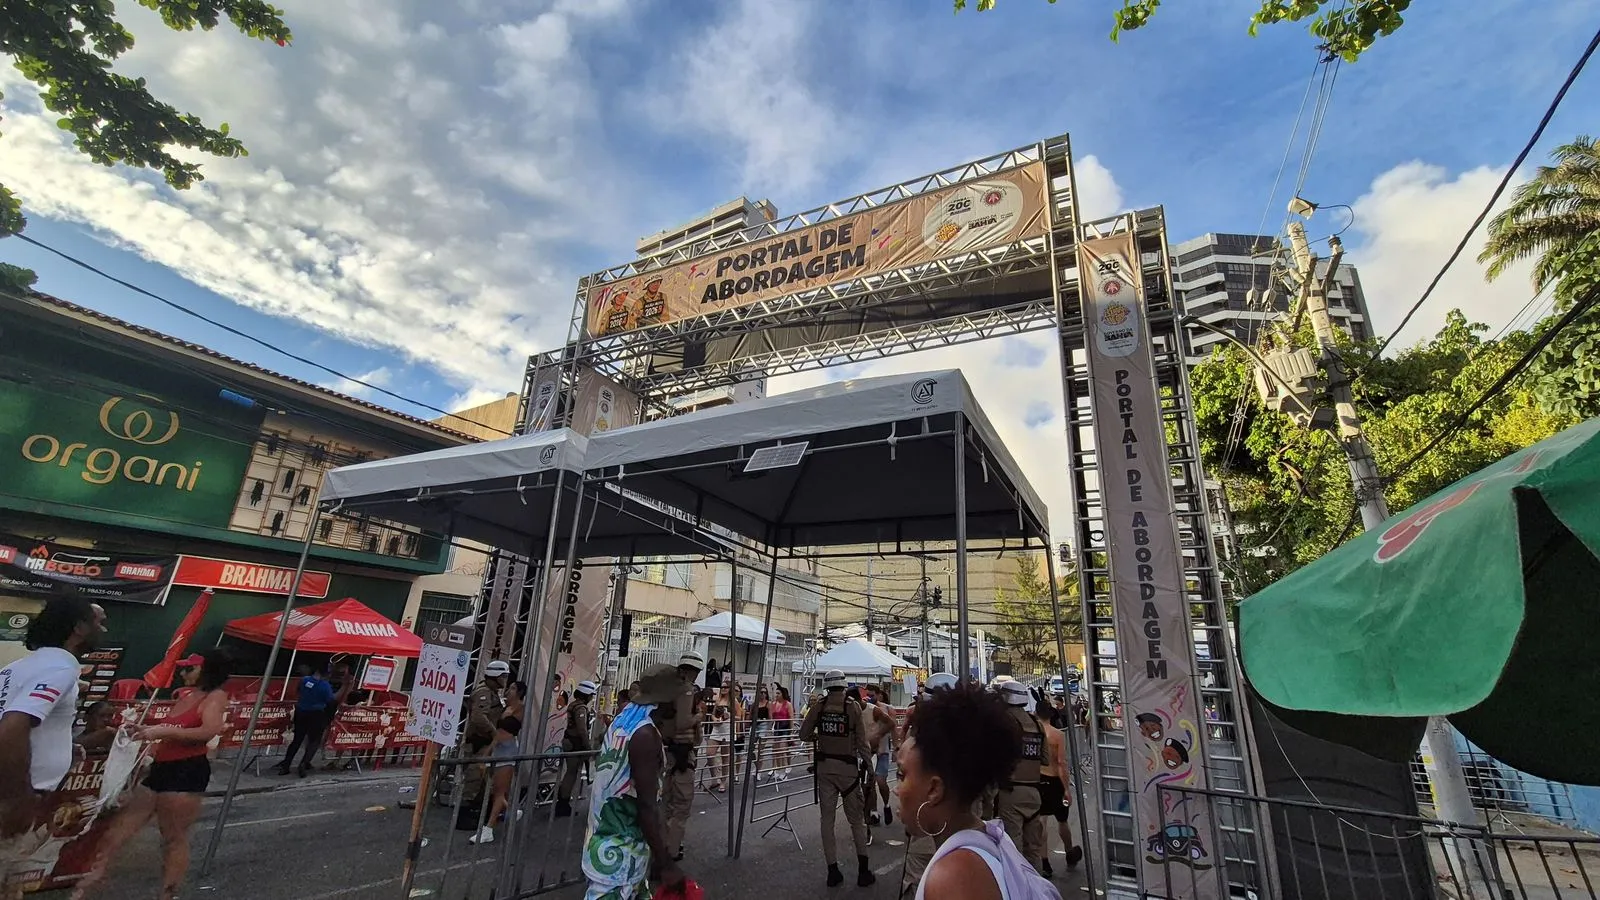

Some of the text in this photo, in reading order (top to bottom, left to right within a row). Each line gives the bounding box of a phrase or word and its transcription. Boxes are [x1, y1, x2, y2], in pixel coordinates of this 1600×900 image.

[716, 223, 853, 278] PORTAL DE
[700, 244, 866, 304] ABORDAGEM
[1115, 369, 1138, 459] PORTAL
[21, 434, 202, 492] organi
[1127, 469, 1142, 502] DE
[119, 565, 156, 578] BRAHMA
[219, 563, 292, 591] BRAHMA
[491, 555, 517, 660] ABORDAGEM
[559, 558, 583, 654] BORDAGEM
[1132, 511, 1168, 680] ABORDAGEM
[333, 618, 398, 638] BRAHMA
[419, 665, 456, 695] SAÍDA
[420, 698, 445, 720] EXIT
[61, 774, 104, 791] ABER
